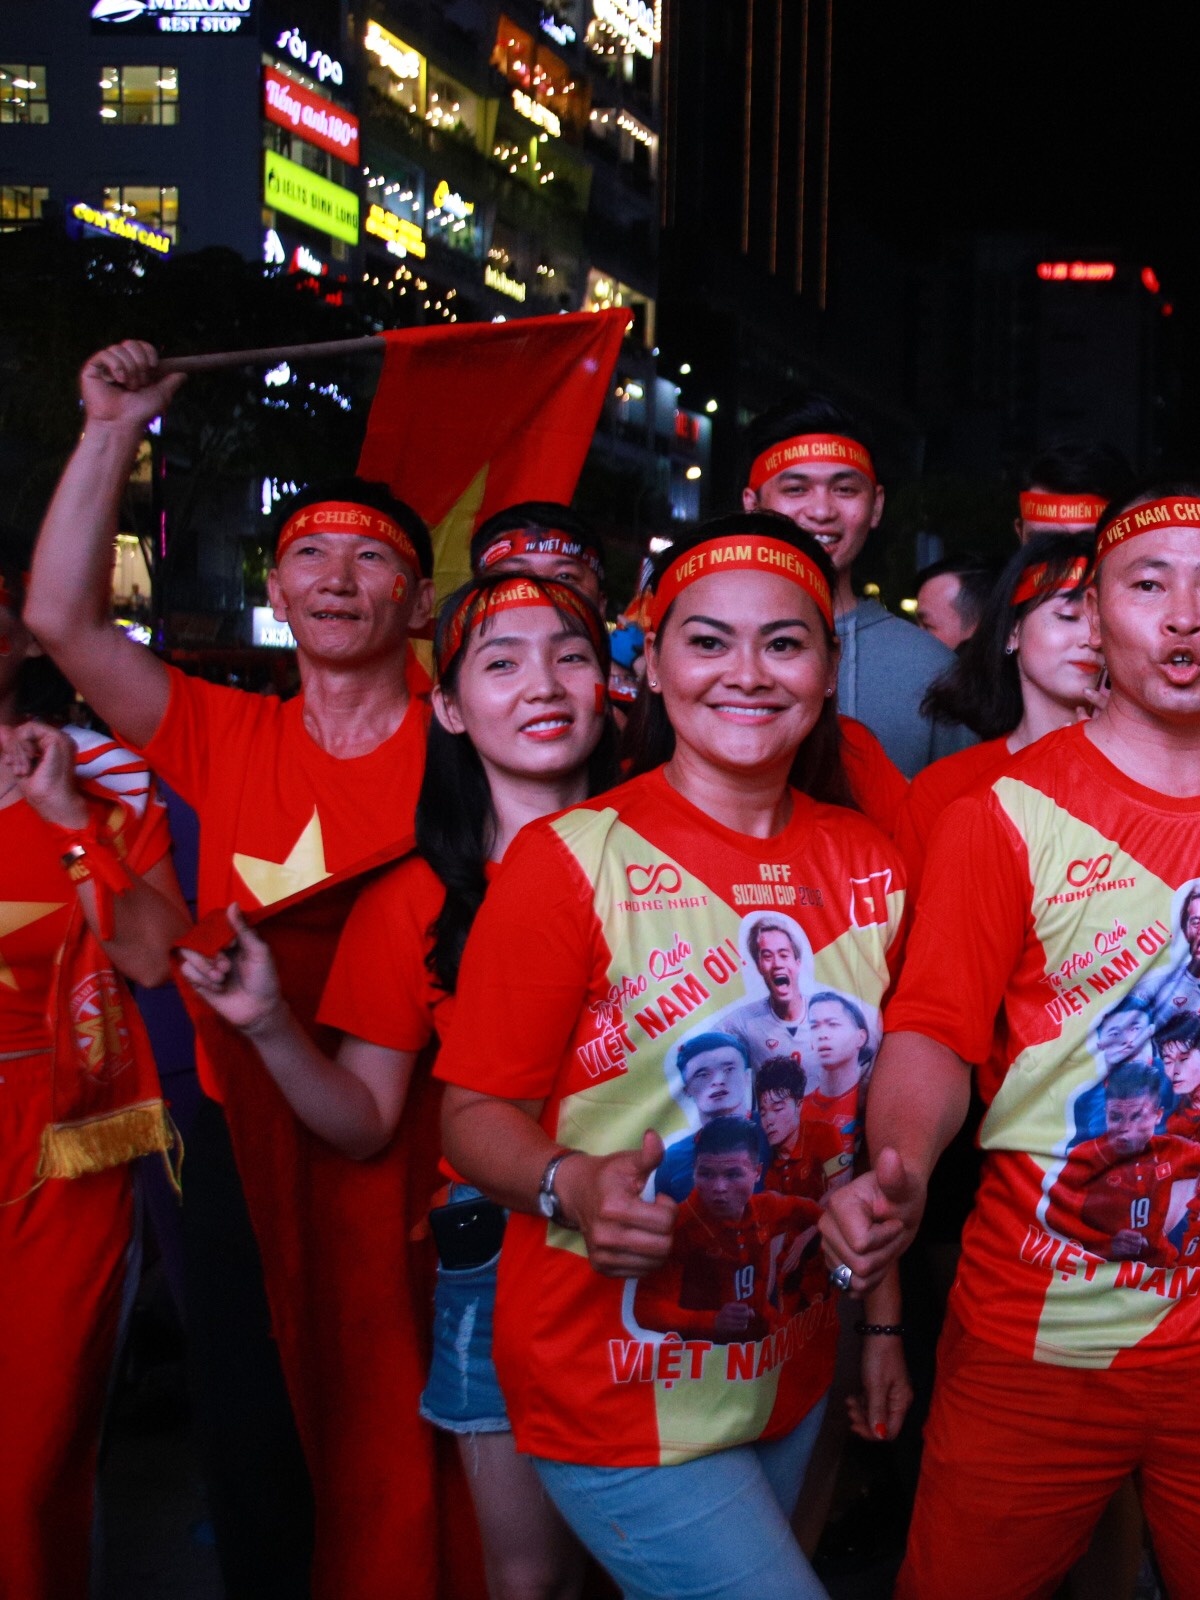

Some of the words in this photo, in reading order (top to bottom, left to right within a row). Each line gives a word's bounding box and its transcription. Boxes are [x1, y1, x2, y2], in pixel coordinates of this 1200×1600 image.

[158, 16, 200, 32] REST
[201, 16, 242, 32] STOP
[784, 444, 809, 461] NAM
[811, 437, 846, 458] CHIẾN
[313, 509, 372, 527] CHIẾN
[1036, 504, 1057, 518] NAM
[1060, 501, 1092, 519] CHIẾN
[1106, 517, 1132, 544] VIỆT
[1134, 504, 1171, 529] NAM
[675, 552, 707, 583] VIỆT
[710, 545, 752, 565] NAM
[757, 546, 805, 579] CHIẾN
[490, 582, 540, 606] CHIẾN
[759, 863, 792, 882] AFF
[732, 884, 775, 905] SUZUKI
[776, 885, 797, 906] CUP
[1094, 919, 1128, 957] Quá
[648, 932, 692, 982] Quá
[1044, 984, 1091, 1025] VIỆT
[1086, 948, 1141, 995] NAM
[576, 1021, 638, 1079] VIỆT
[633, 972, 711, 1040] NAM
[1129, 1197, 1150, 1229] 19
[1019, 1224, 1107, 1283] VIỆT
[735, 1264, 755, 1300] 19
[608, 1331, 713, 1391] VIỆT
[726, 1327, 794, 1380] NAM
